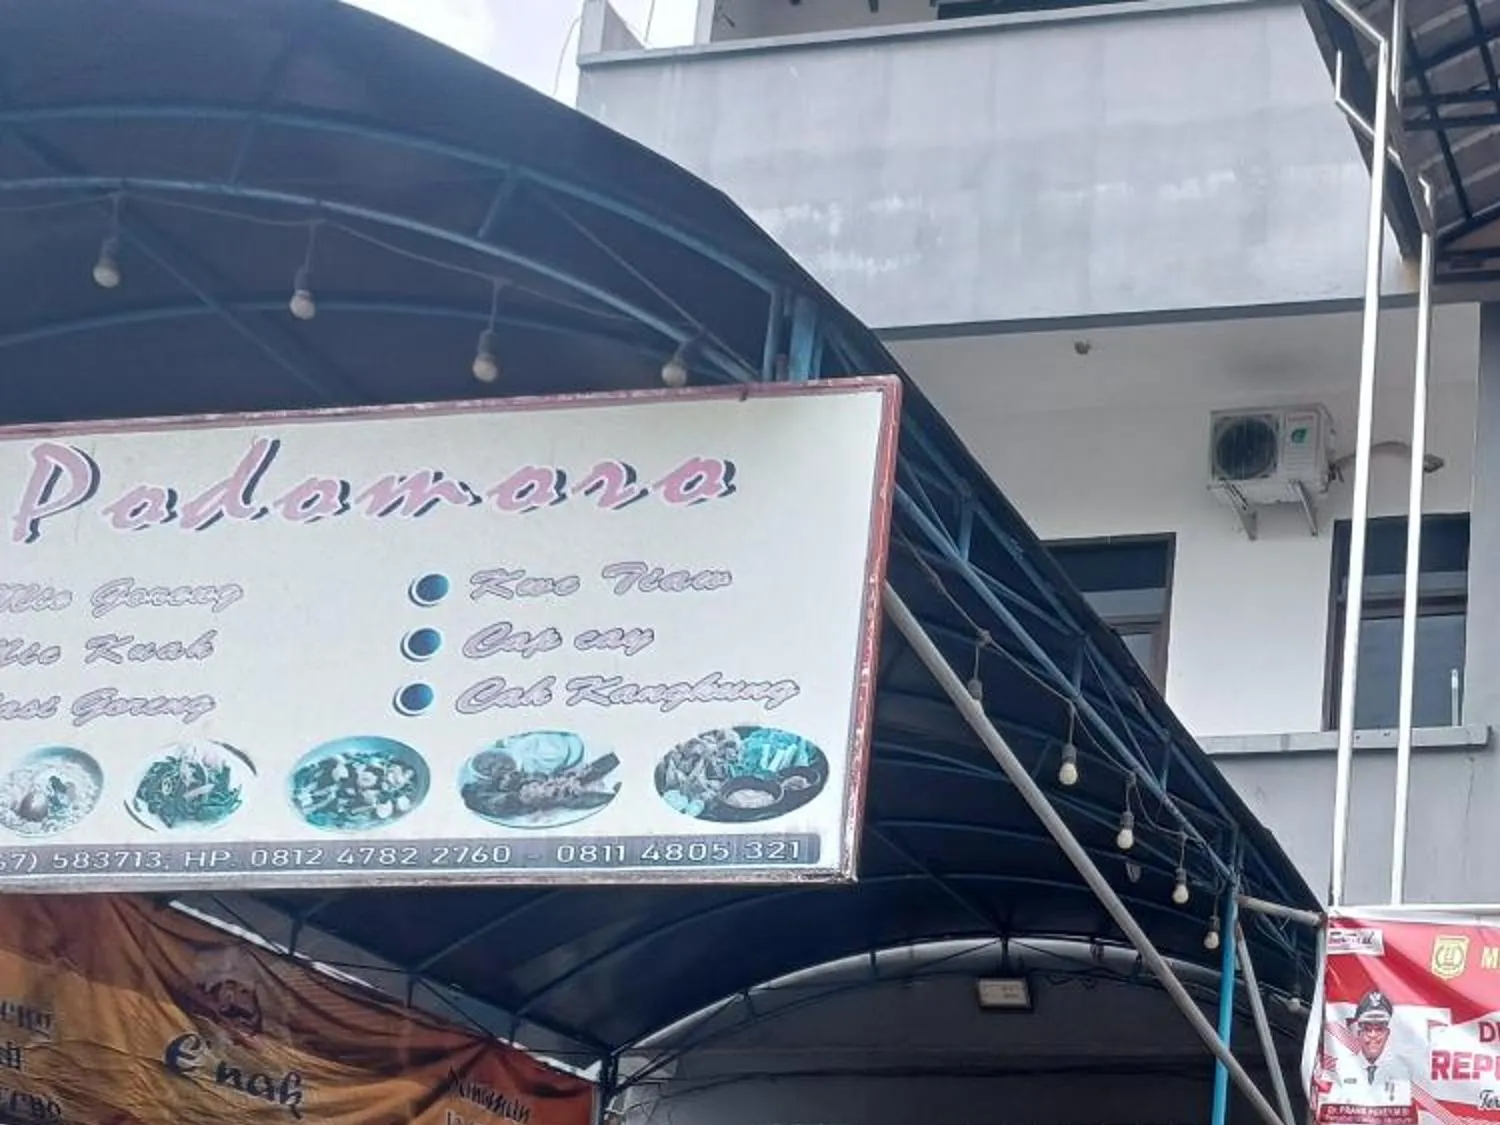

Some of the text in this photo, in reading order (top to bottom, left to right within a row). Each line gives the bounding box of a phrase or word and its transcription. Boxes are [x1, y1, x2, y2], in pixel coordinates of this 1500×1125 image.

[0, 691, 61, 720] asi
[251, 847, 325, 867] 0812
[337, 846, 418, 866] 4782
[431, 846, 511, 864] 2760
[557, 844, 626, 863] 0811
[641, 843, 730, 862] 4805
[745, 841, 801, 860] 321
